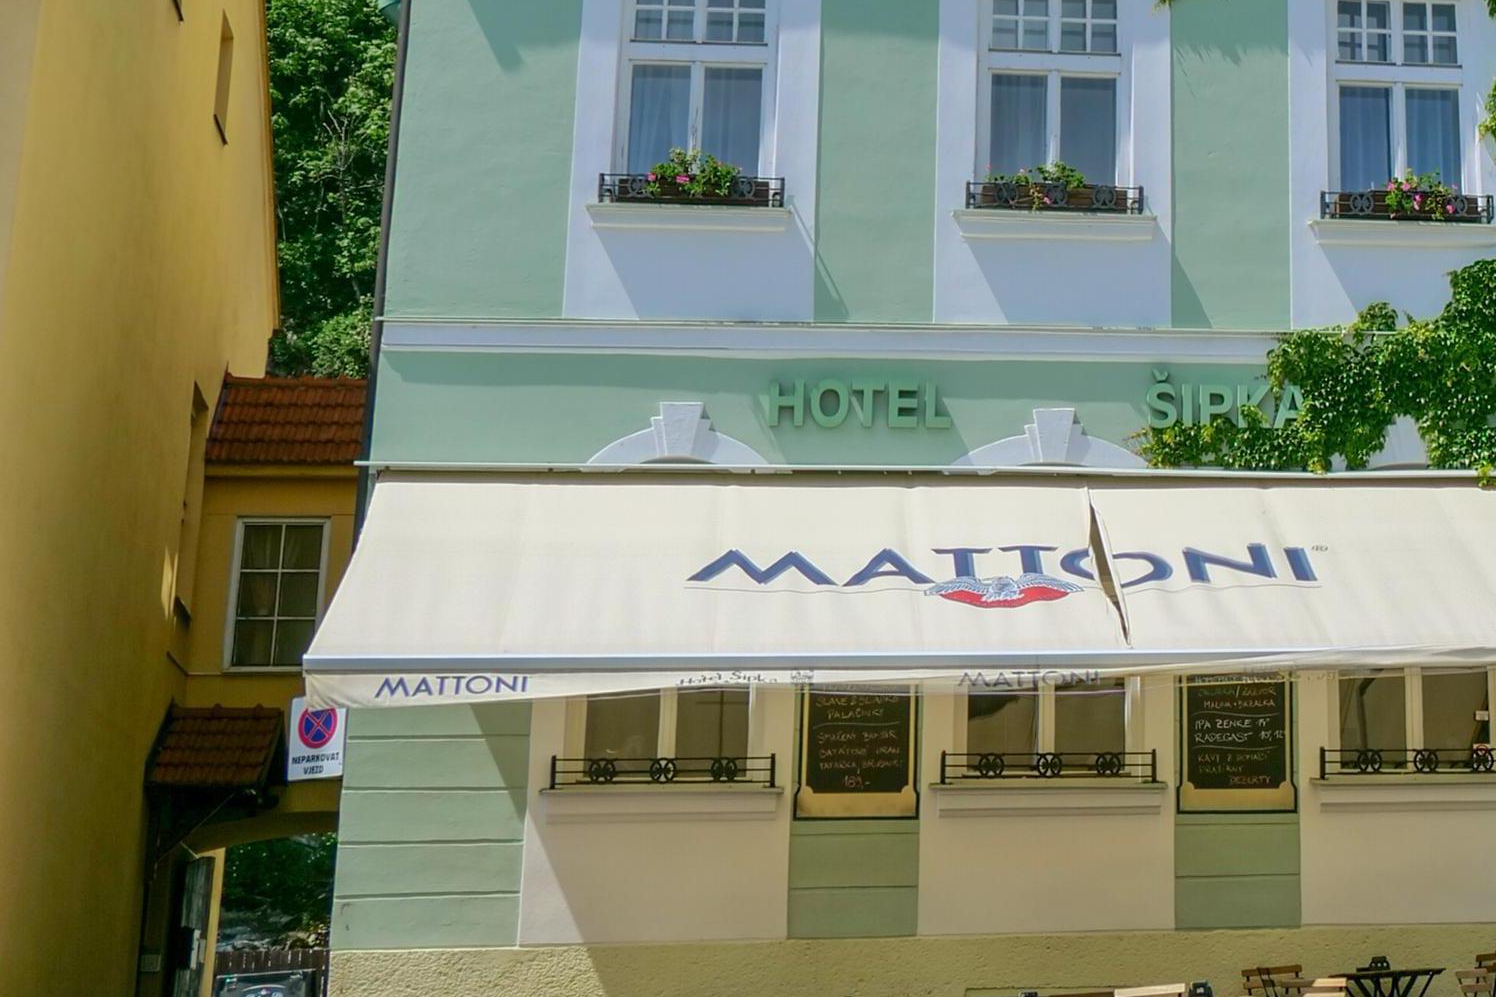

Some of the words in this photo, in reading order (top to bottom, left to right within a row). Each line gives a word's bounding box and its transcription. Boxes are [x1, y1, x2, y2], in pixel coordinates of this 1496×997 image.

[768, 378, 952, 430] HOTEL
[1147, 369, 1304, 429] ŠIPKA
[686, 543, 1318, 588] MATTONI
[374, 675, 528, 698] MATTONI
[957, 669, 1100, 688] MATTONI
